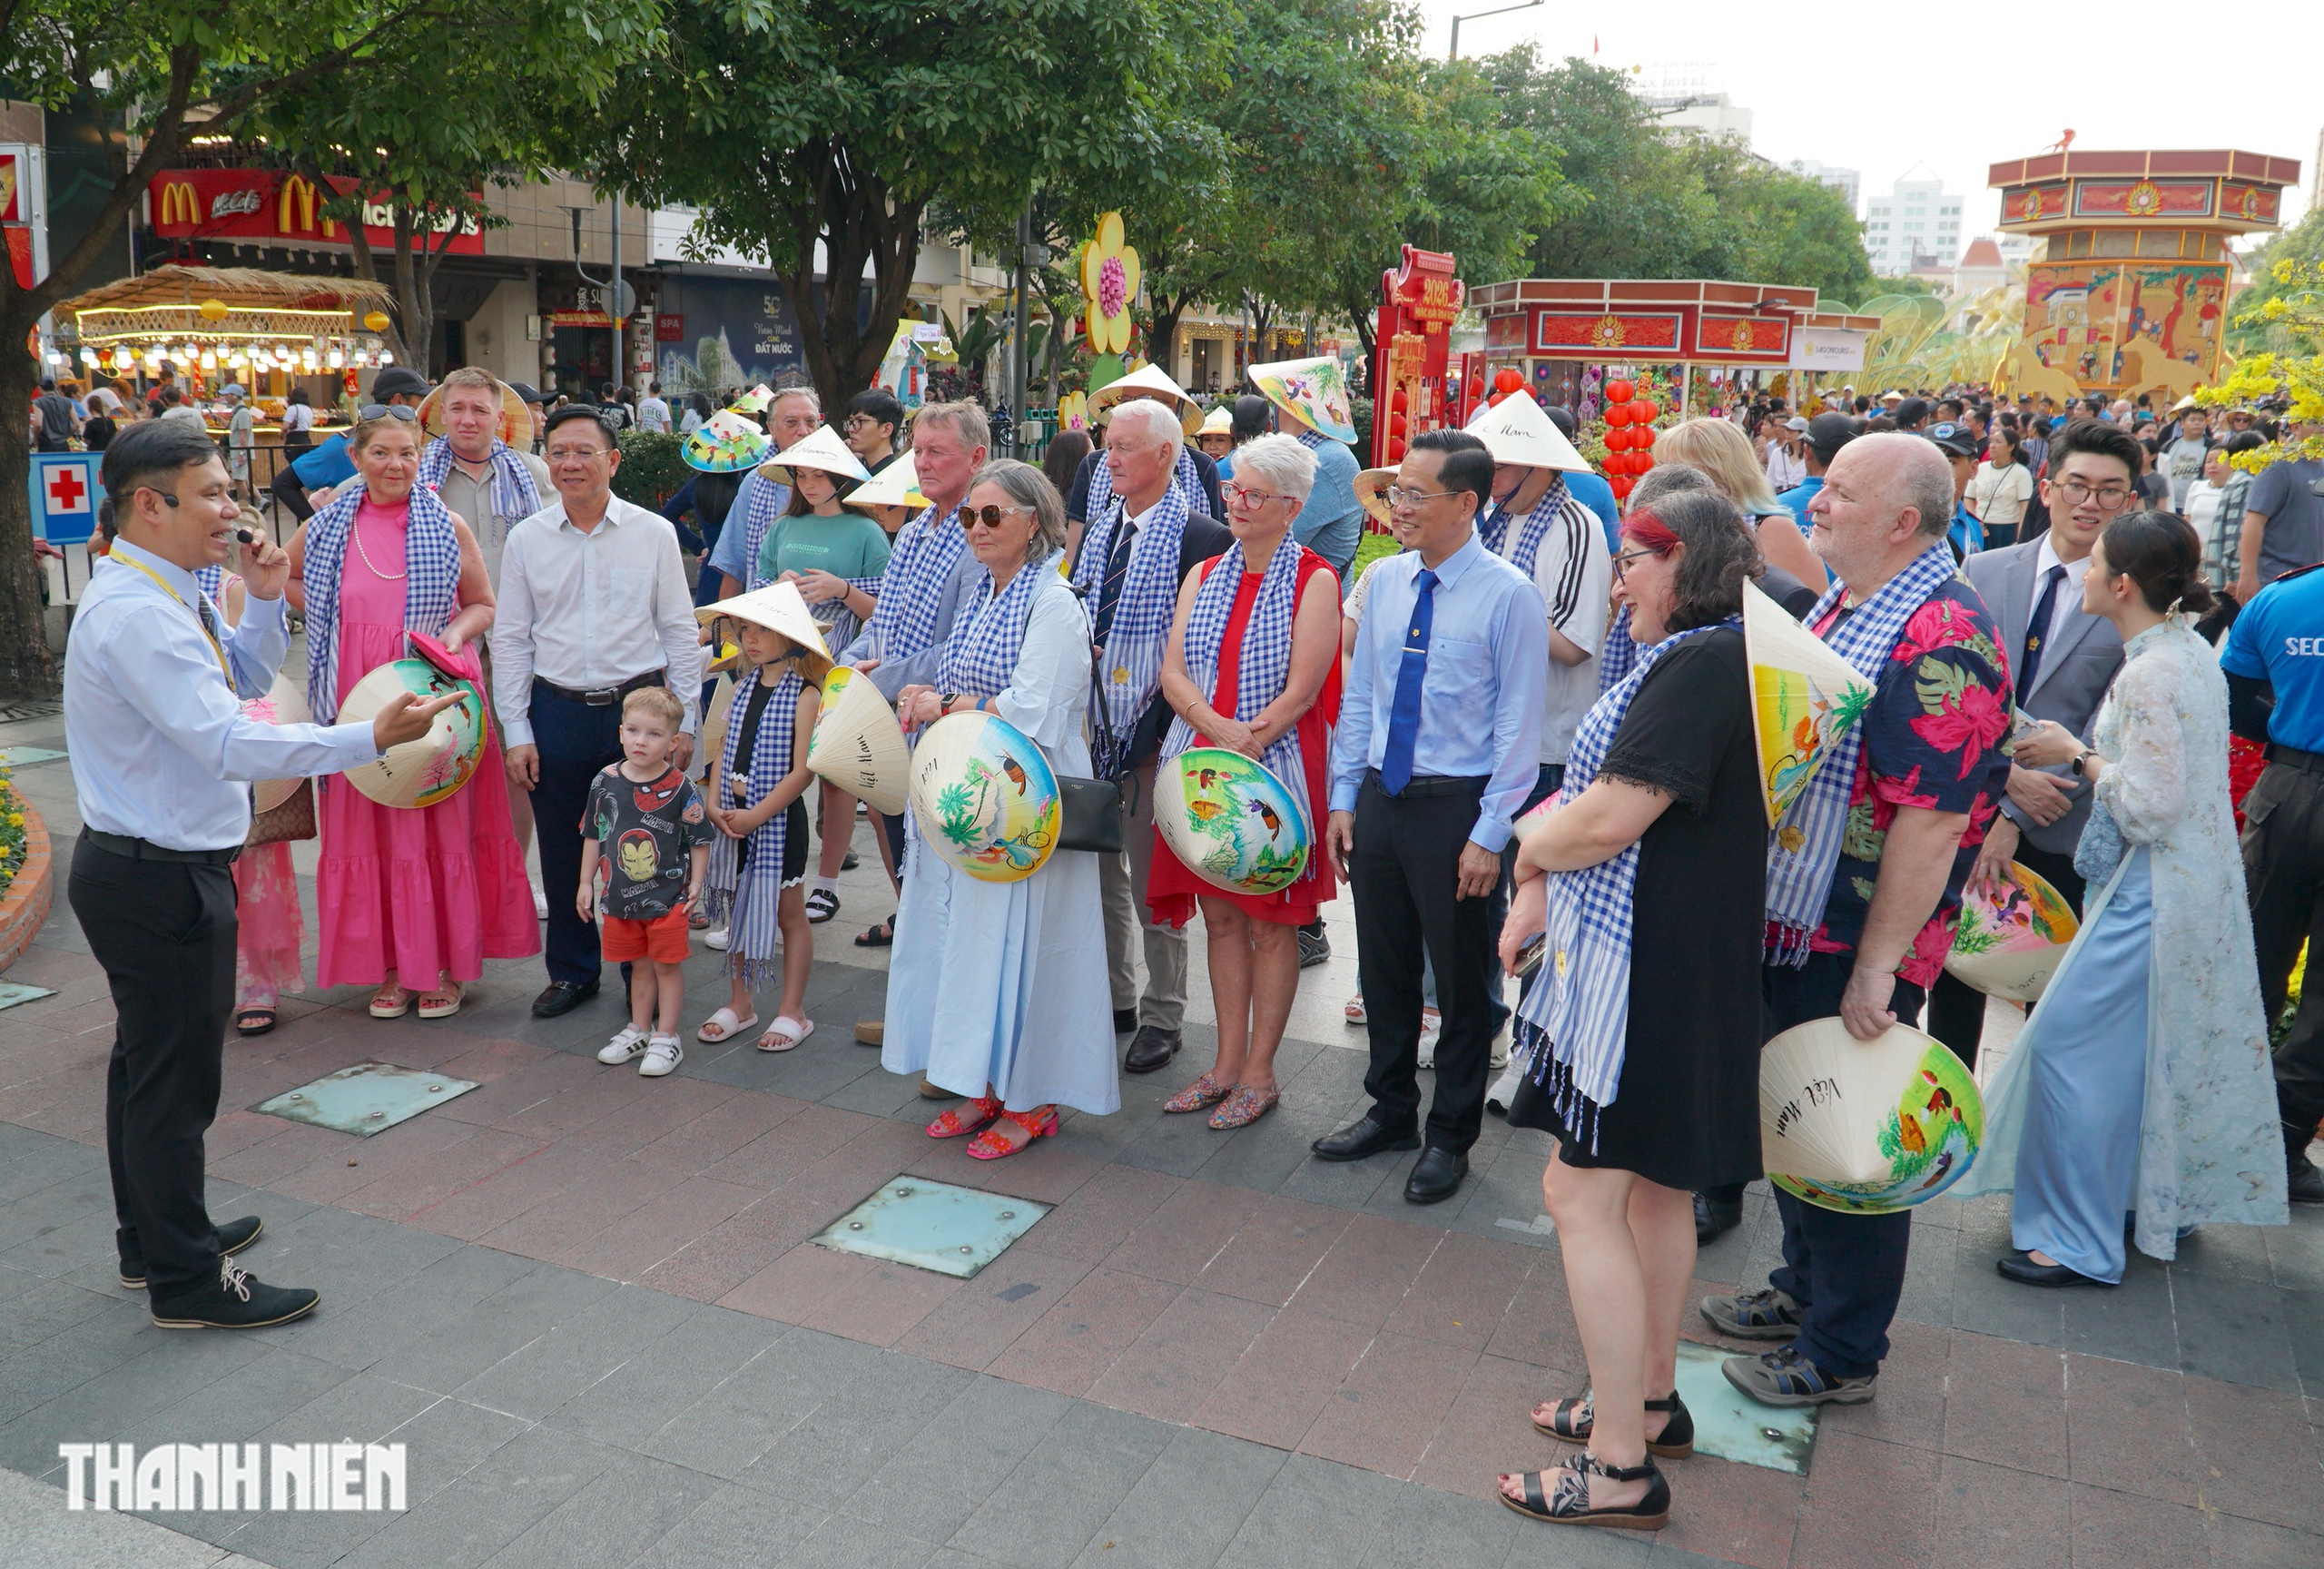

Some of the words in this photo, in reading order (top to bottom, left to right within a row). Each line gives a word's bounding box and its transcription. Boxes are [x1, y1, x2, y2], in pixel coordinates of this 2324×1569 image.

[1423, 277, 1450, 307] 2026
[660, 319, 679, 328] SPA
[2285, 637, 2324, 656] SEC
[640, 813, 674, 834] MARVEL
[621, 879, 659, 899] MARVEL
[1803, 1078, 1842, 1112] Việt
